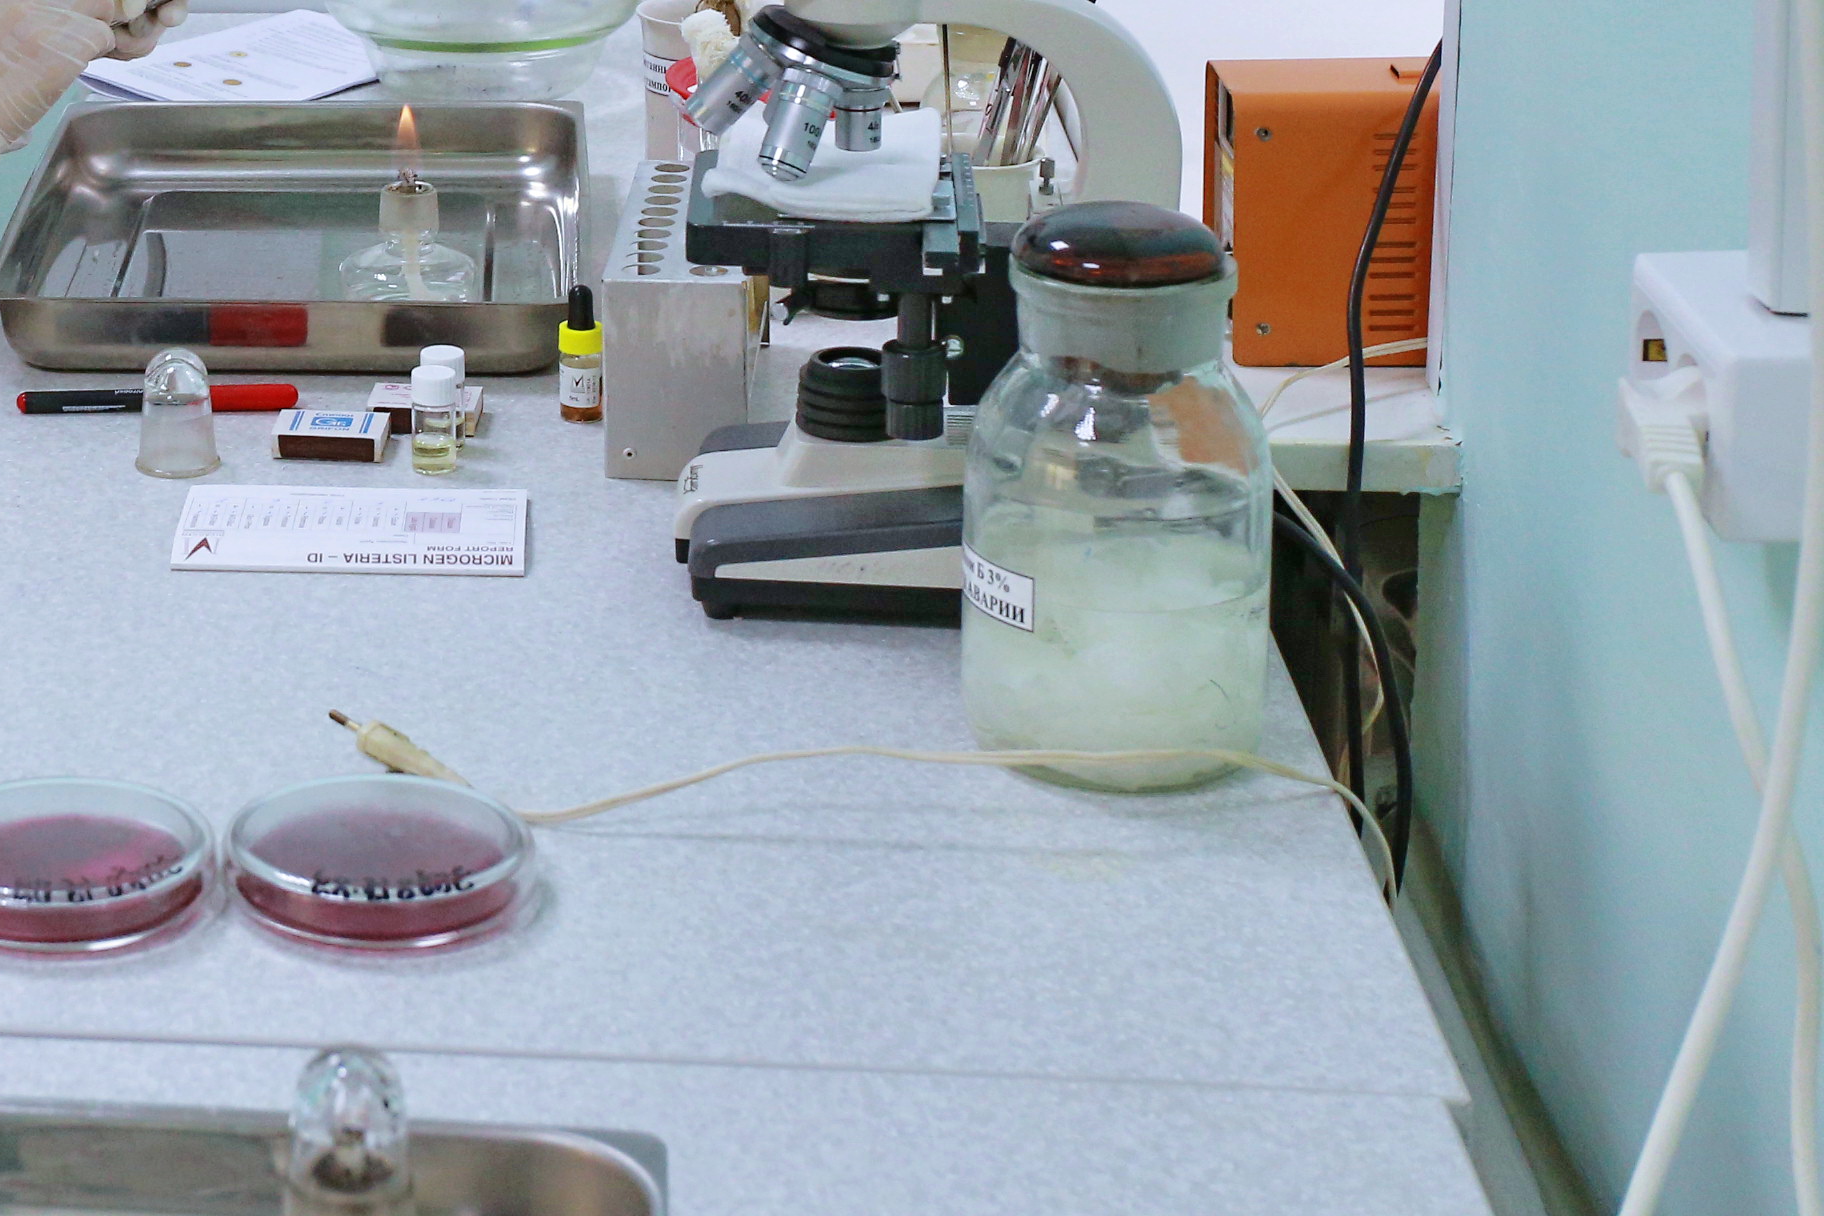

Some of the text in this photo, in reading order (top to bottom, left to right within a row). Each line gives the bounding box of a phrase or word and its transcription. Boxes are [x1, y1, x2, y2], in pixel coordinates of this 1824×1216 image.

[307, 551, 324, 564] ID
[343, 552, 418, 565] LISTERIA
[422, 553, 514, 566] MICROGEN
[987, 569, 1010, 593] 3%
[967, 581, 1026, 623] АВАРИИ
